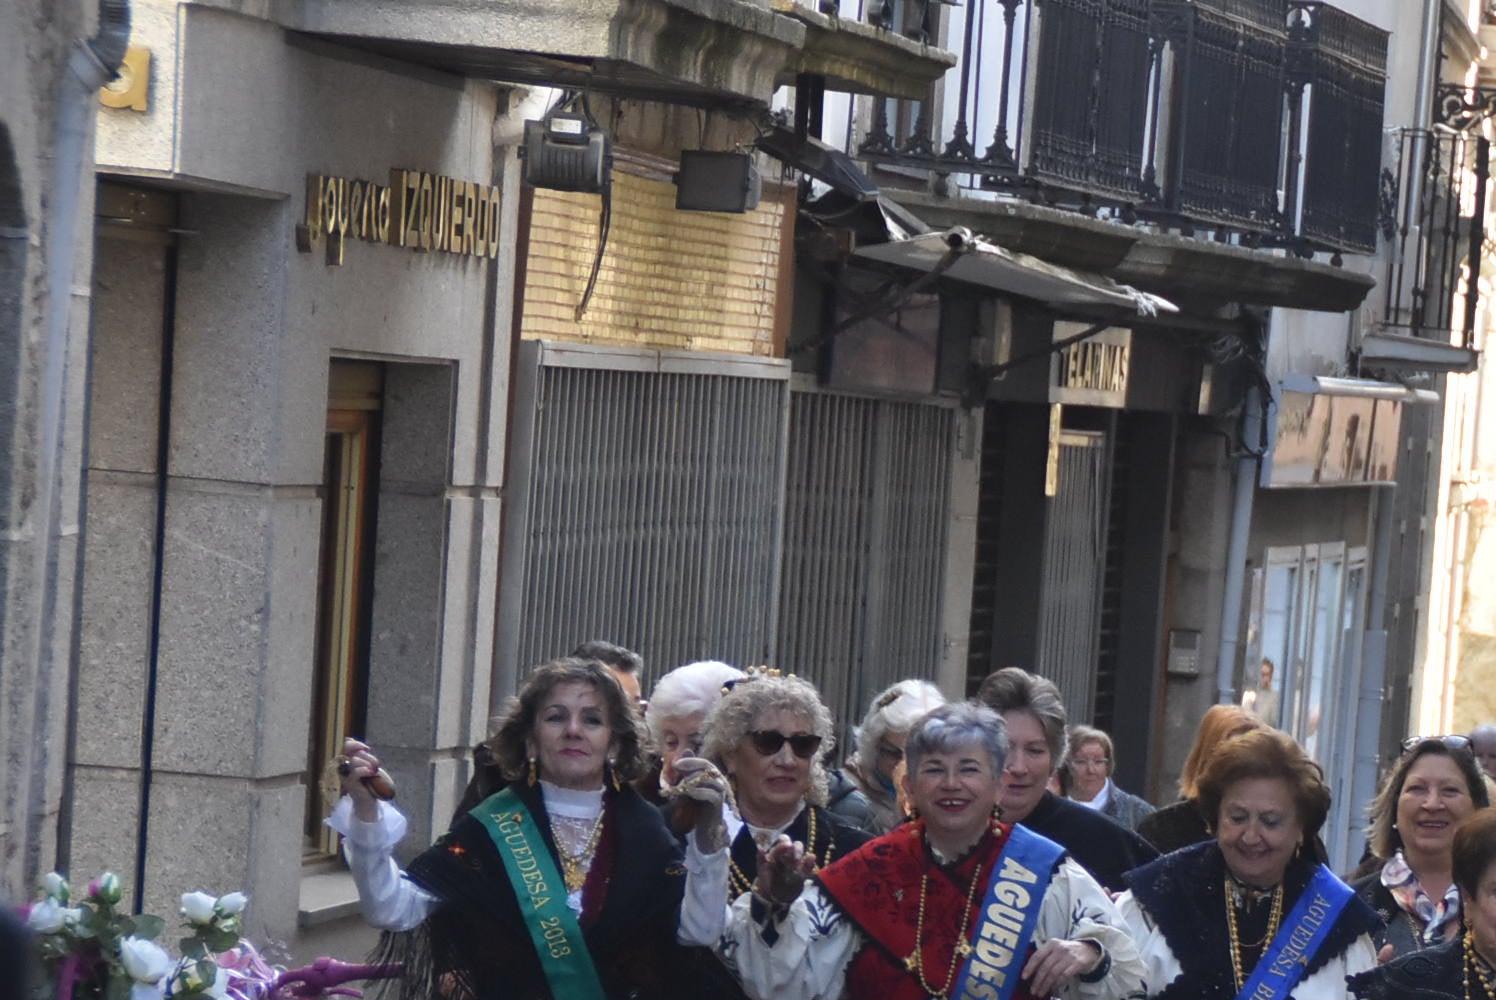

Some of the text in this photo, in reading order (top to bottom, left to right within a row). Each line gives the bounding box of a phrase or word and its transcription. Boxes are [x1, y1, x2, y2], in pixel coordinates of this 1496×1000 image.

[400, 170, 499, 258] IZQUIERDO
[491, 812, 572, 959] AGUEDESA 2013
[1269, 893, 1332, 977] AGUEDESA
